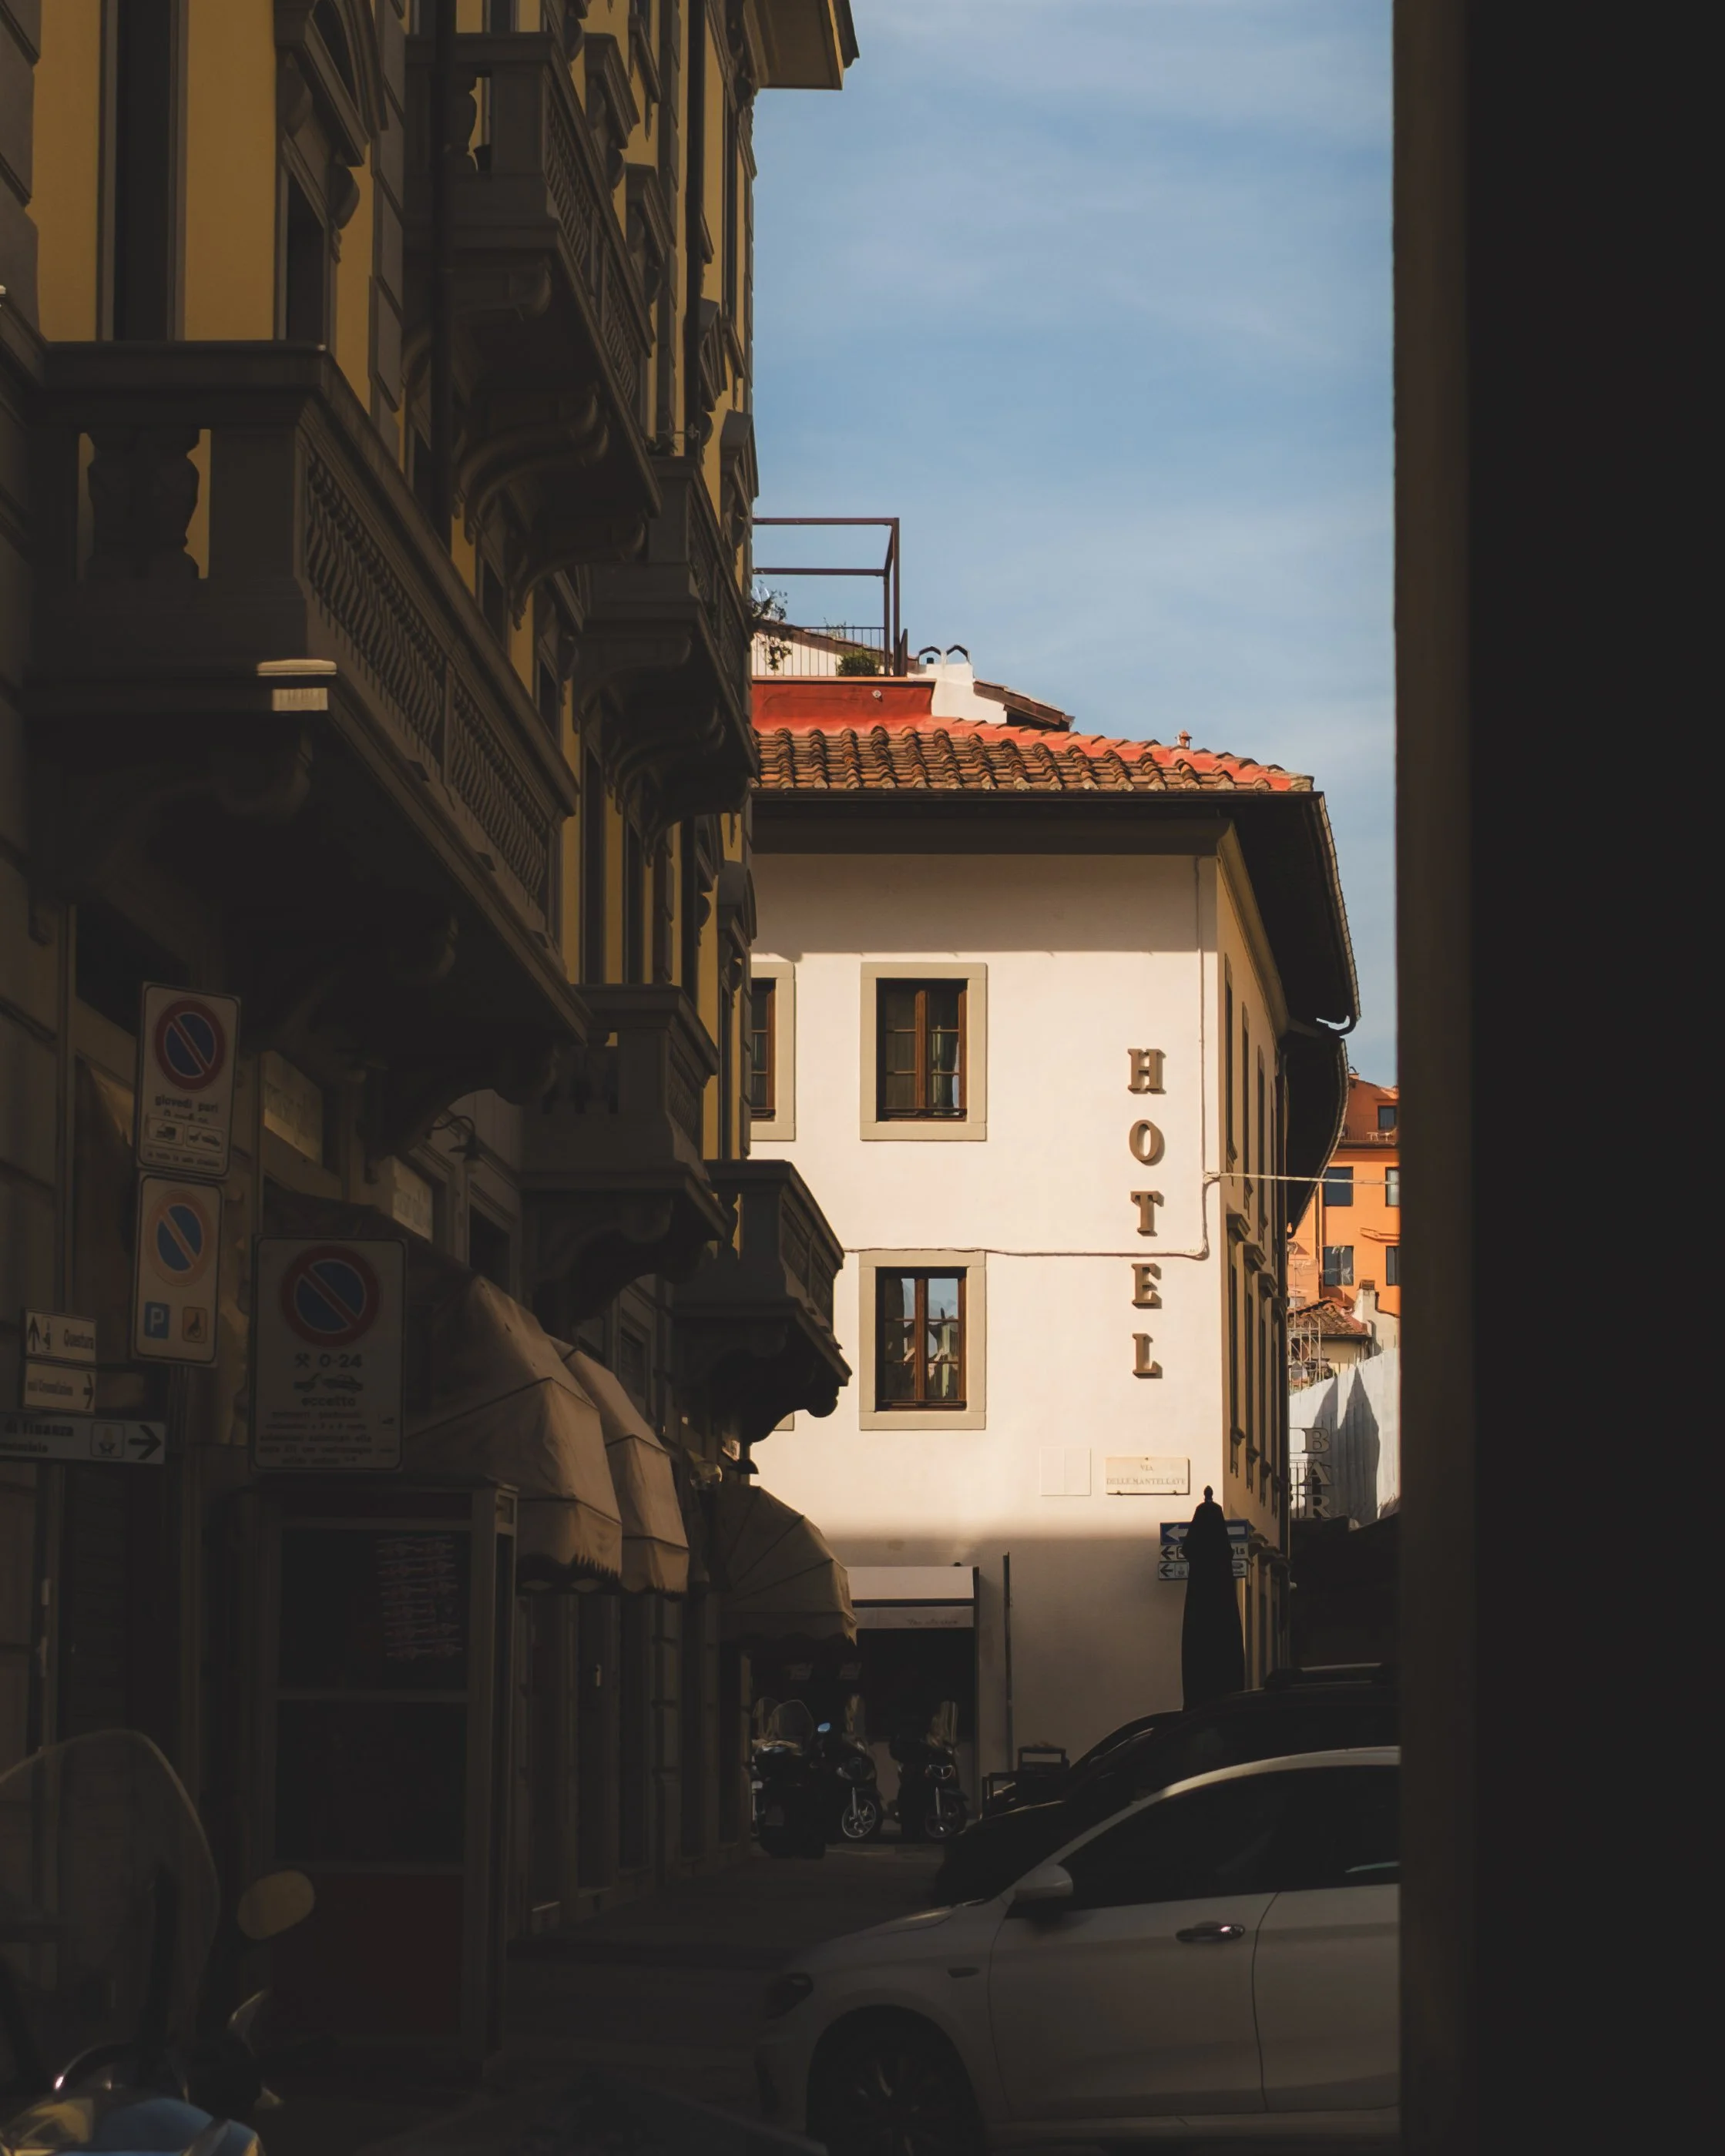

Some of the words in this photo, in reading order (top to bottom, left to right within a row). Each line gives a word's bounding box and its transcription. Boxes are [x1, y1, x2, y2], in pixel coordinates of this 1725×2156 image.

[1128, 1048, 1166, 1379] HOTEL
[319, 1353, 363, 1368] 0-24
[301, 1396, 356, 1407] eccetto
[1300, 1427, 1331, 1519] BAR
